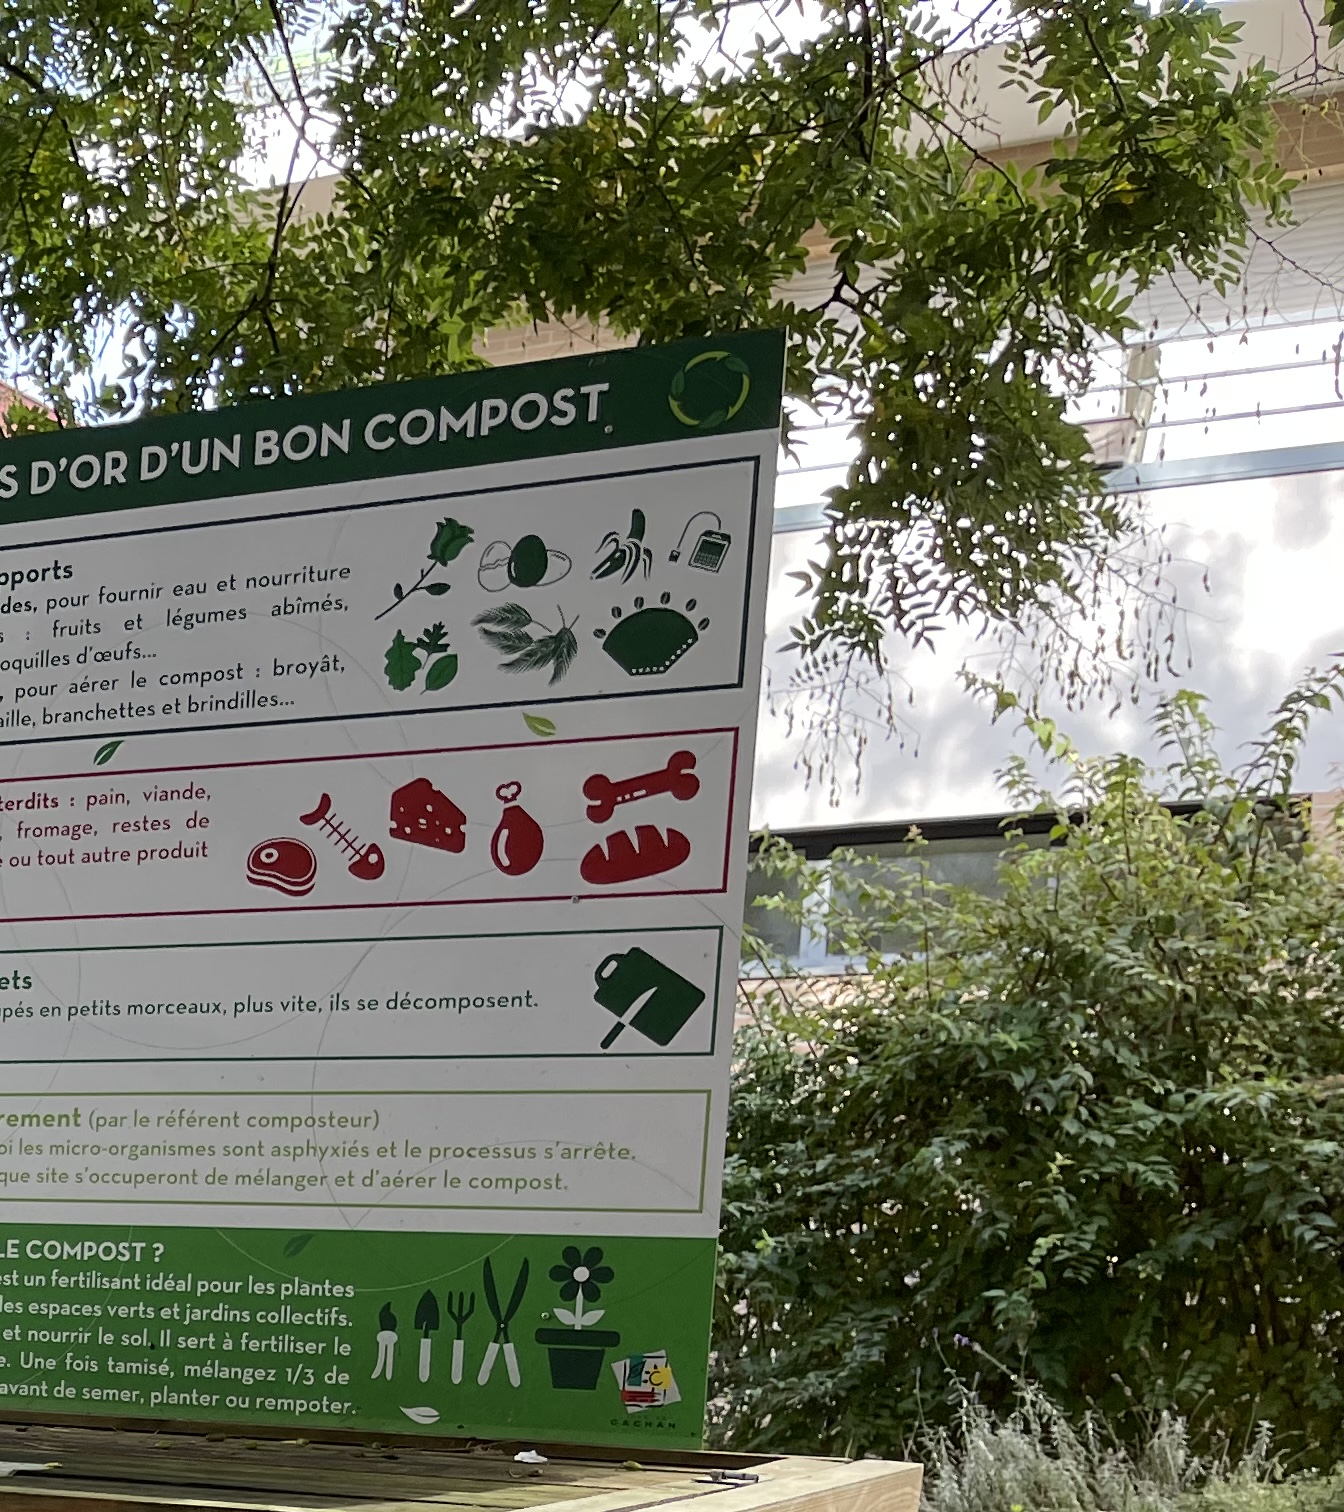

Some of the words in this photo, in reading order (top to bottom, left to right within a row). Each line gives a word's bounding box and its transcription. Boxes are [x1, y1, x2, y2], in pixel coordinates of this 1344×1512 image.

[253, 417, 351, 466] BON
[363, 381, 610, 450] COMPOST
[41, 700, 156, 725] branchettes
[161, 696, 181, 715] et
[186, 689, 295, 713] brindilles...
[16, 819, 98, 841] fromage,
[111, 813, 171, 834] restes
[184, 808, 210, 829] de
[87, 1108, 128, 1133] (par
[132, 1107, 151, 1128] le
[155, 1107, 240, 1128] référent
[245, 1108, 380, 1134] composteur)
[24, 1238, 146, 1262] COMPOST
[22, 1273, 46, 1287] un
[49, 1267, 141, 1290] fertilisant
[145, 1271, 192, 1292] idéal
[195, 1279, 243, 1297] pour
[247, 1273, 275, 1295] les
[279, 1275, 355, 1301] plantes
